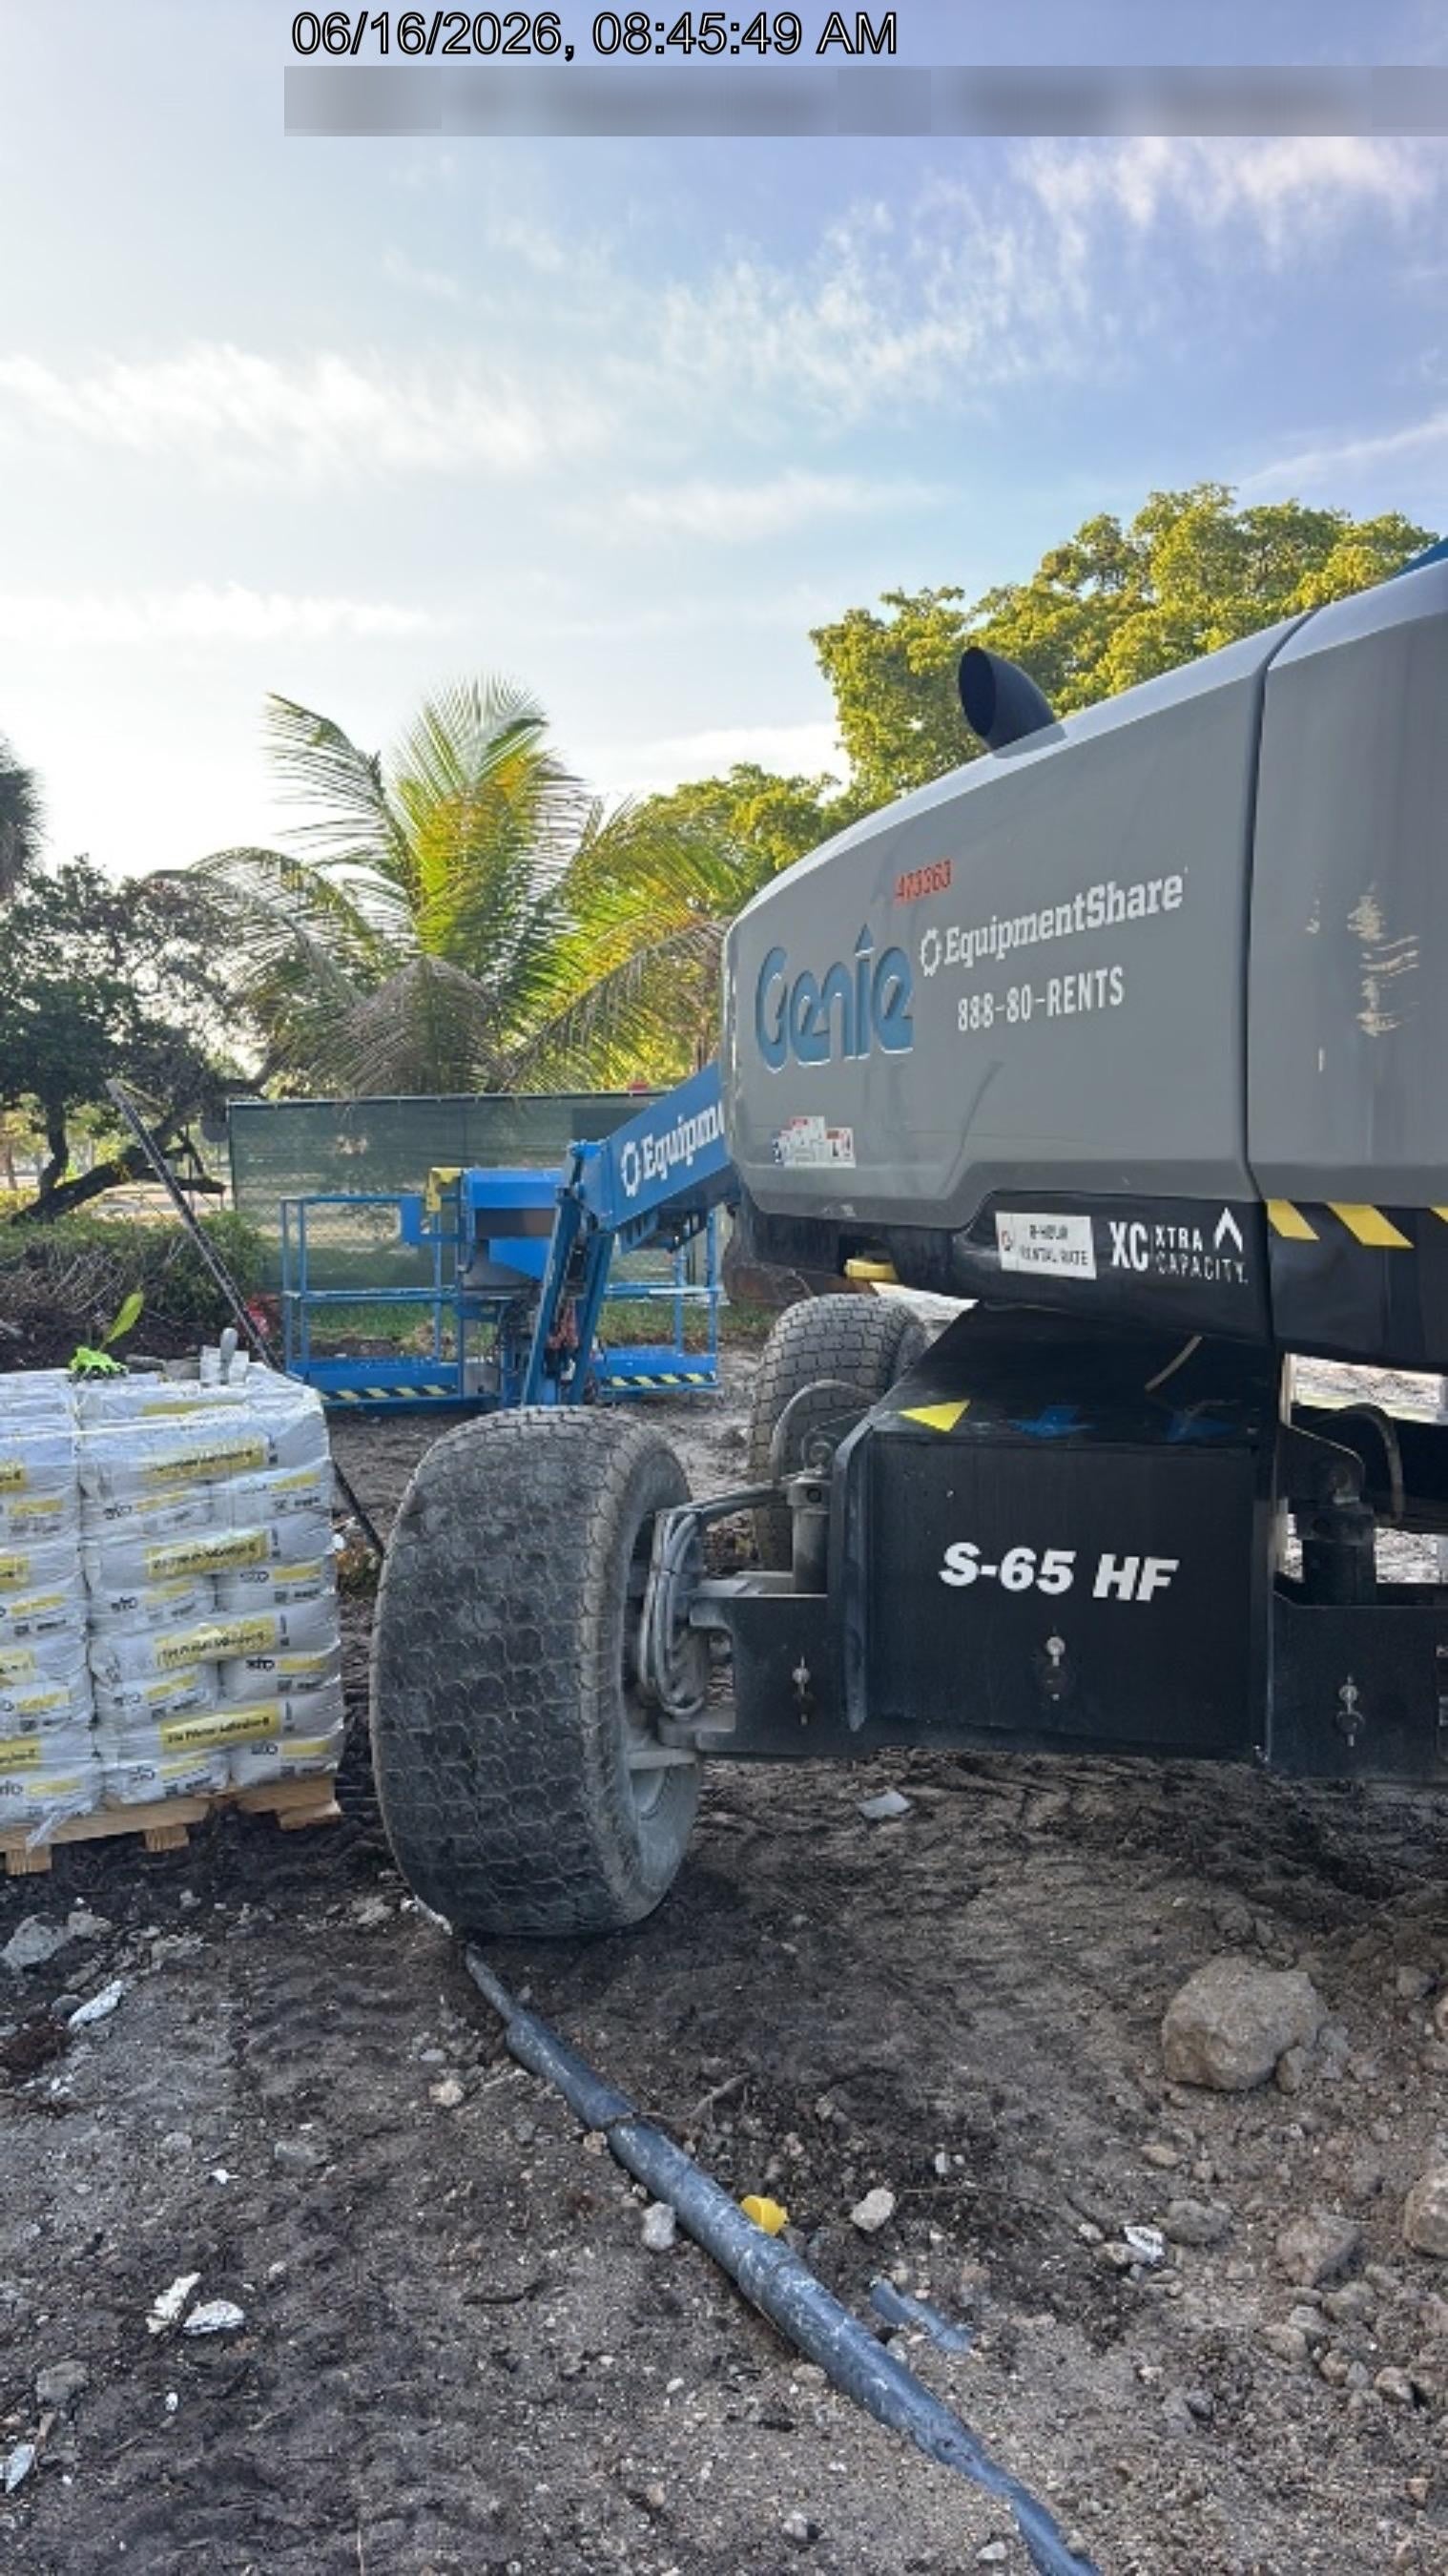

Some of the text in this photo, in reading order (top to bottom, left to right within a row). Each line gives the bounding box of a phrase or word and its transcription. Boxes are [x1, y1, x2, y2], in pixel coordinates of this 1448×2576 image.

[944, 875, 1184, 967] EquipmentShare
[755, 922, 914, 1074] Genie
[957, 966, 1125, 1031] 888-80-RENTS
[1107, 1221, 1148, 1272] XC
[1155, 1225, 1203, 1253] XTRA
[939, 1542, 1180, 1603] S-65 HF
